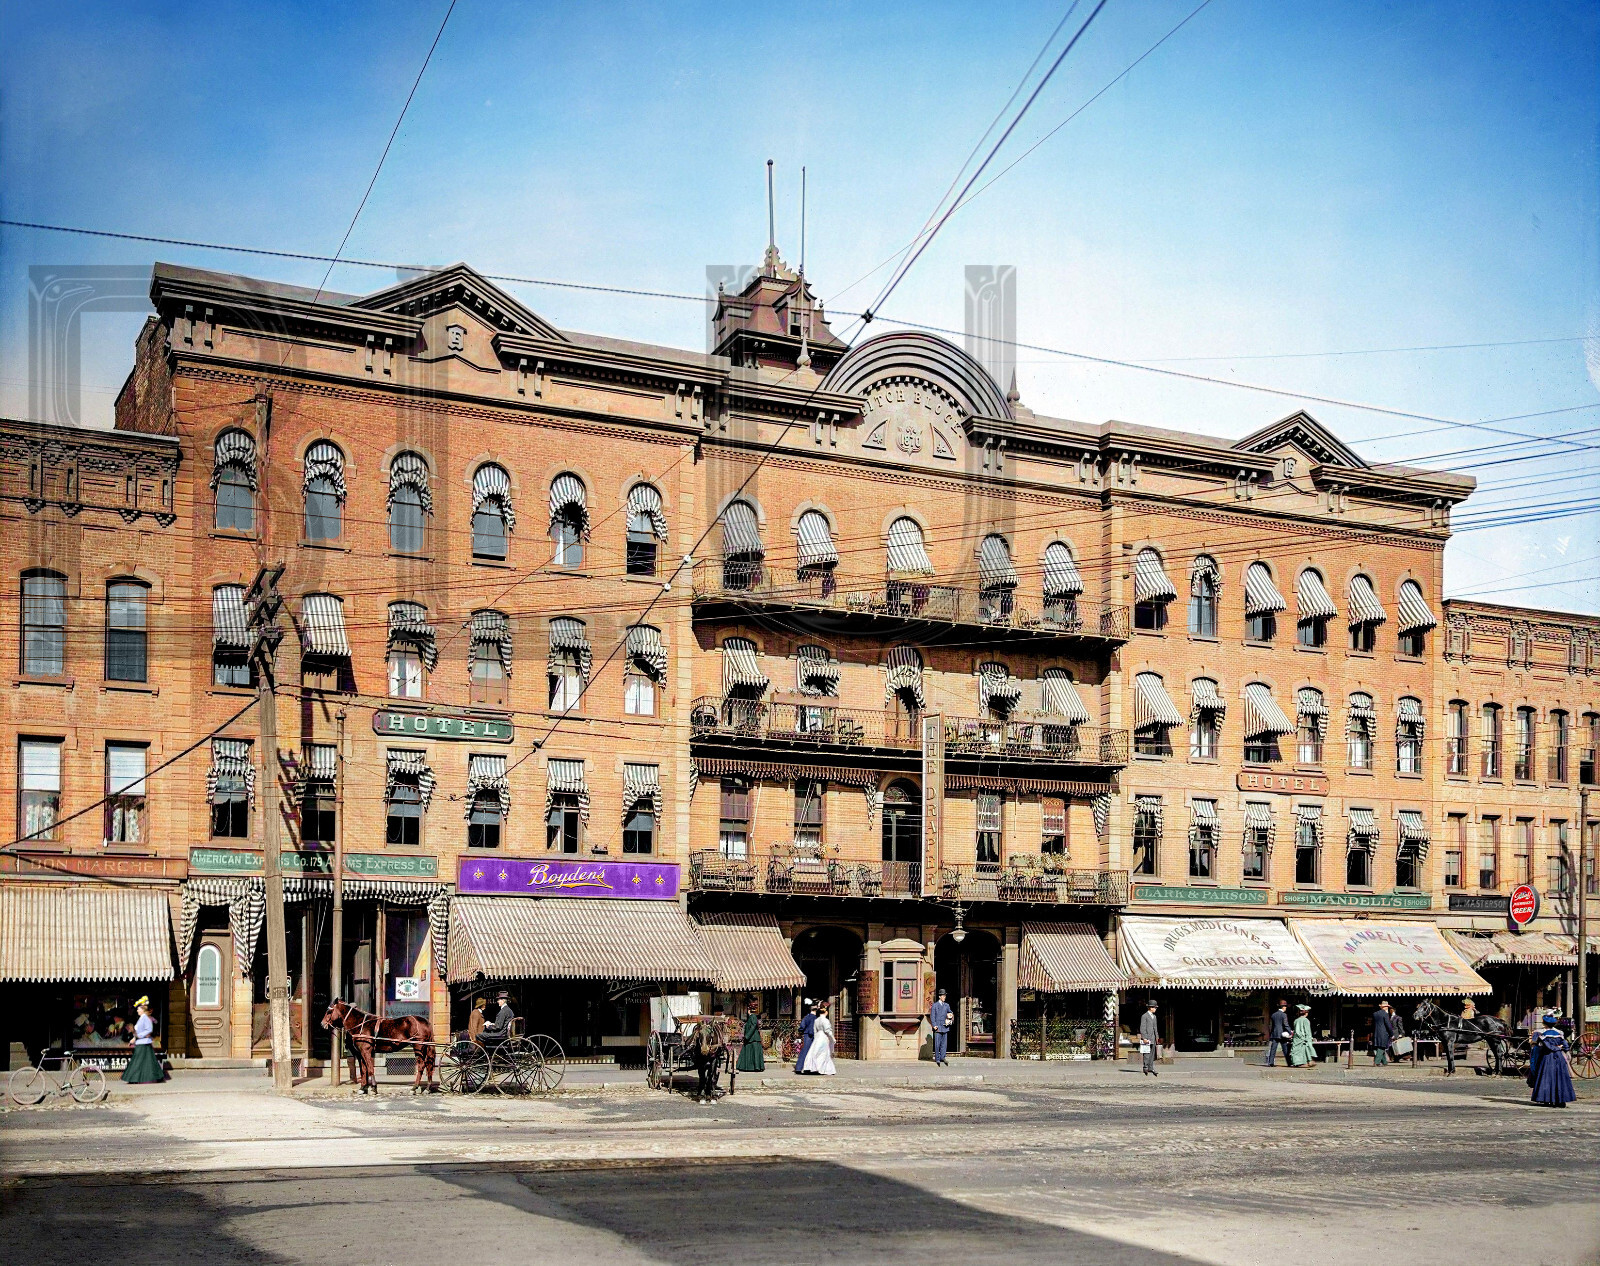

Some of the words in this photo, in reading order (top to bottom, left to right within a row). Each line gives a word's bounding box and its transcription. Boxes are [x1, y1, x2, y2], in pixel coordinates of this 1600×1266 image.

[388, 714, 499, 737] HOTEL
[925, 726, 938, 775] THE
[1247, 774, 1320, 792] HOTEL
[924, 786, 938, 887] DRAPER
[77, 859, 155, 873] MARCHE
[191, 850, 241, 866] AMERICAN
[244, 852, 290, 867] EXPS
[310, 856, 323, 868] 179
[325, 857, 362, 869] AAMS
[366, 857, 415, 871] EXPRESS
[526, 863, 614, 890] Boyden's
[1135, 888, 1185, 899] CLARK
[1187, 889, 1200, 899] &
[1202, 890, 1266, 902] PARSONS
[1283, 895, 1306, 903] SHOES
[1309, 894, 1403, 907] MANDELL'S
[1341, 961, 1459, 975] SHOES
[1166, 978, 1194, 986] SODA
[1198, 978, 1234, 986] WATER
[1236, 978, 1243, 986] &
[1246, 978, 1280, 986] TOILET
[1282, 978, 1326, 986] ARTICLES
[1373, 985, 1461, 993] MANDELL'S
[80, 1057, 108, 1067] NEW
